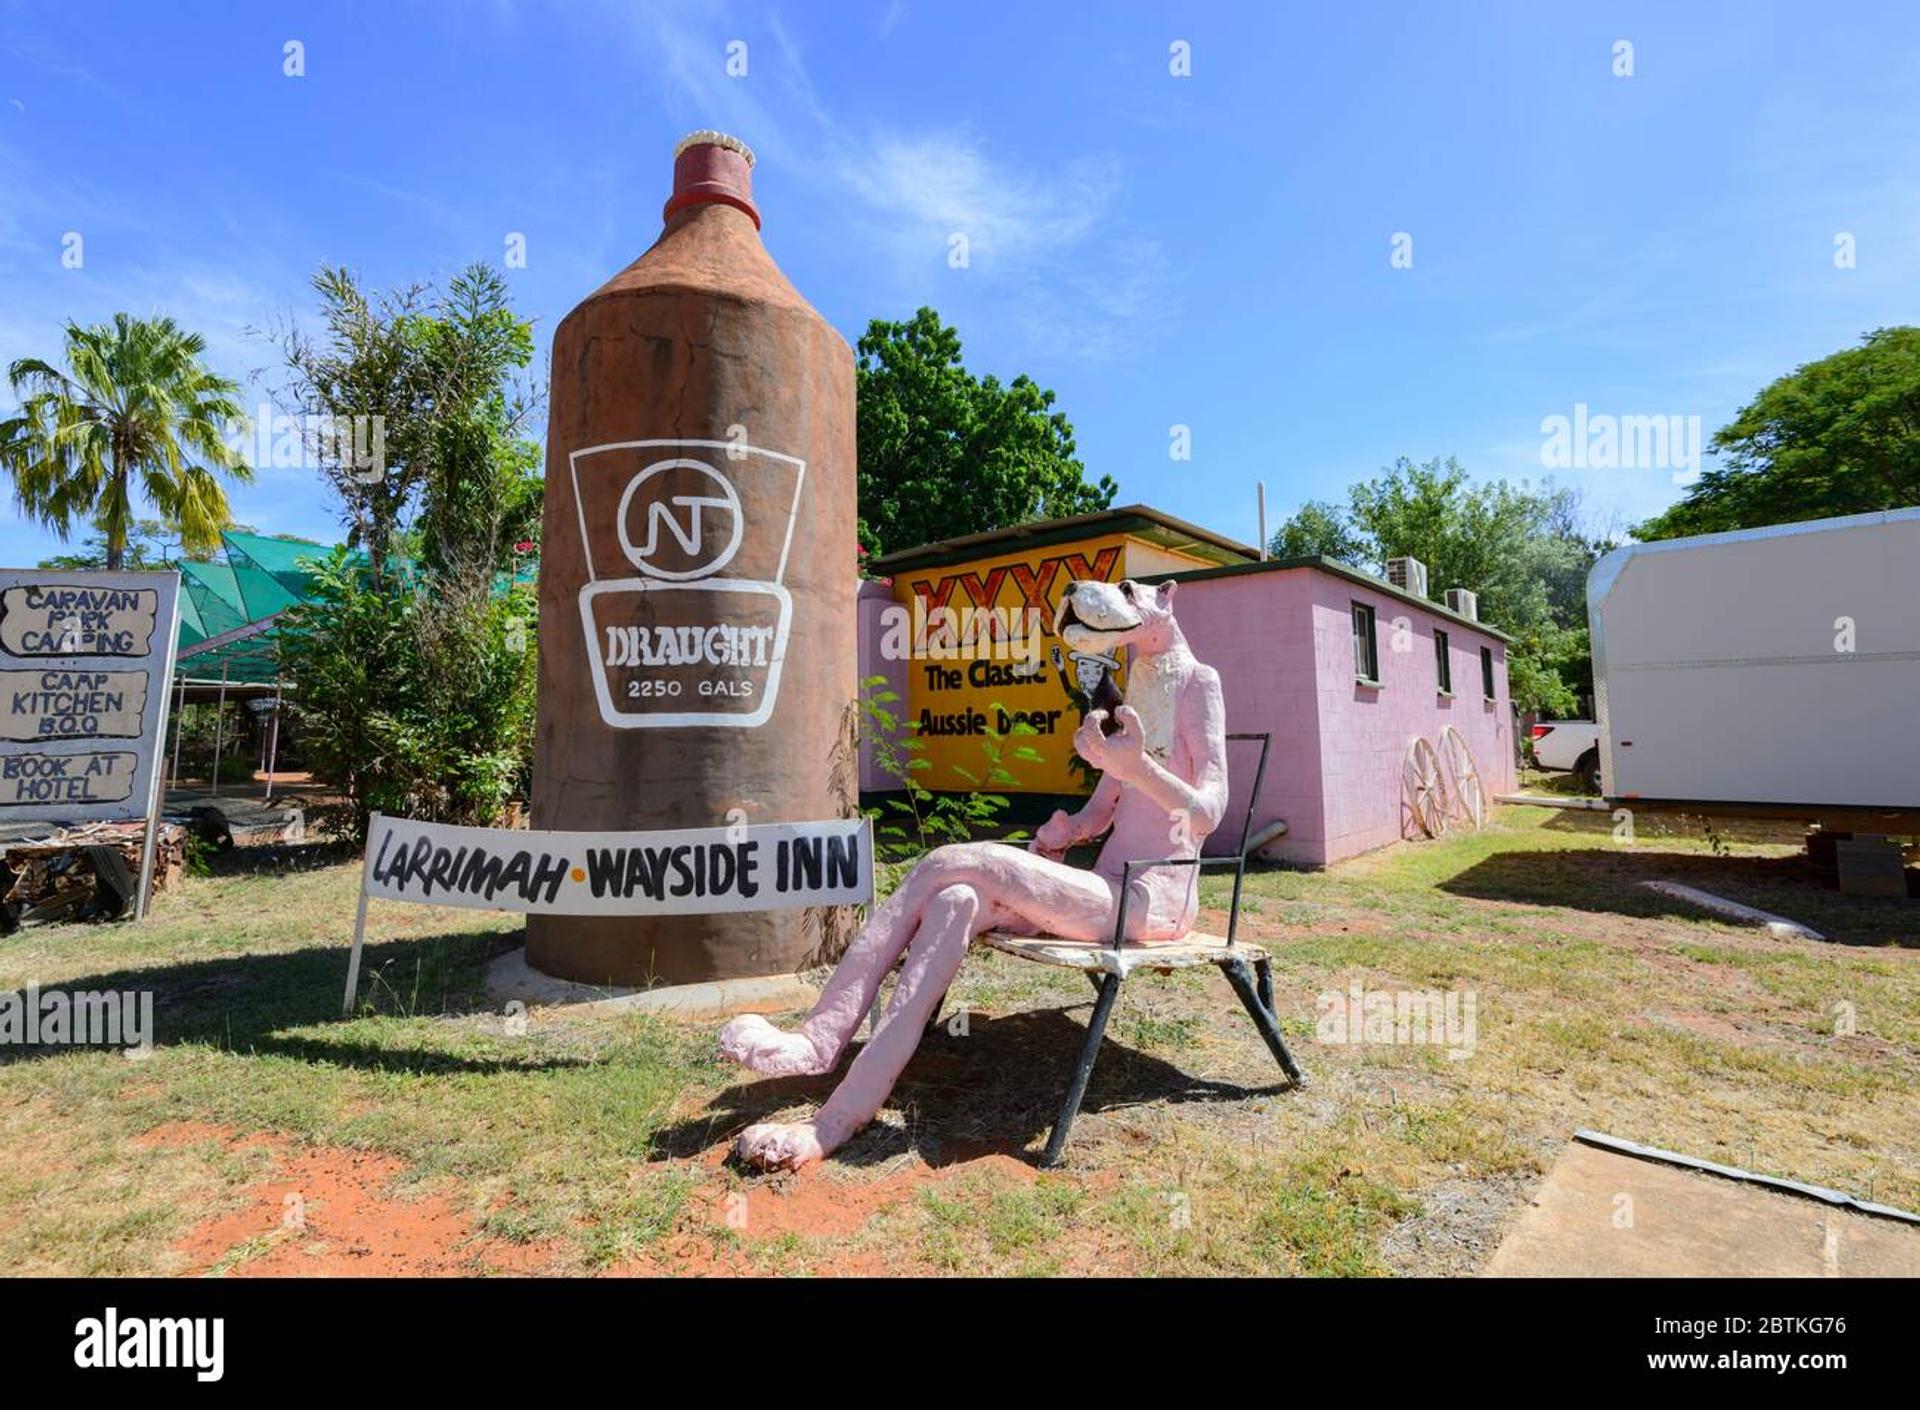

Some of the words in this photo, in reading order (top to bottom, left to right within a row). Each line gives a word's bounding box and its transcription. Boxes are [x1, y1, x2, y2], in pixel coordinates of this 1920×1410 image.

[25, 590, 140, 611] CARAVAN
[605, 625, 774, 667] DRAUGHT
[41, 672, 109, 691] CAMP
[924, 664, 963, 691] The
[968, 659, 1047, 688] Classic
[628, 681, 682, 697] 2250
[698, 680, 753, 697] GALS
[11, 692, 124, 715] KITCHEN
[917, 707, 987, 736] Aussie
[3, 757, 72, 779] BOOK
[84, 755, 120, 776] AT
[16, 777, 98, 800] HOTEL
[372, 828, 570, 903] LARRIMAH
[586, 840, 759, 899] WAYSIDE
[776, 834, 859, 891] INN
